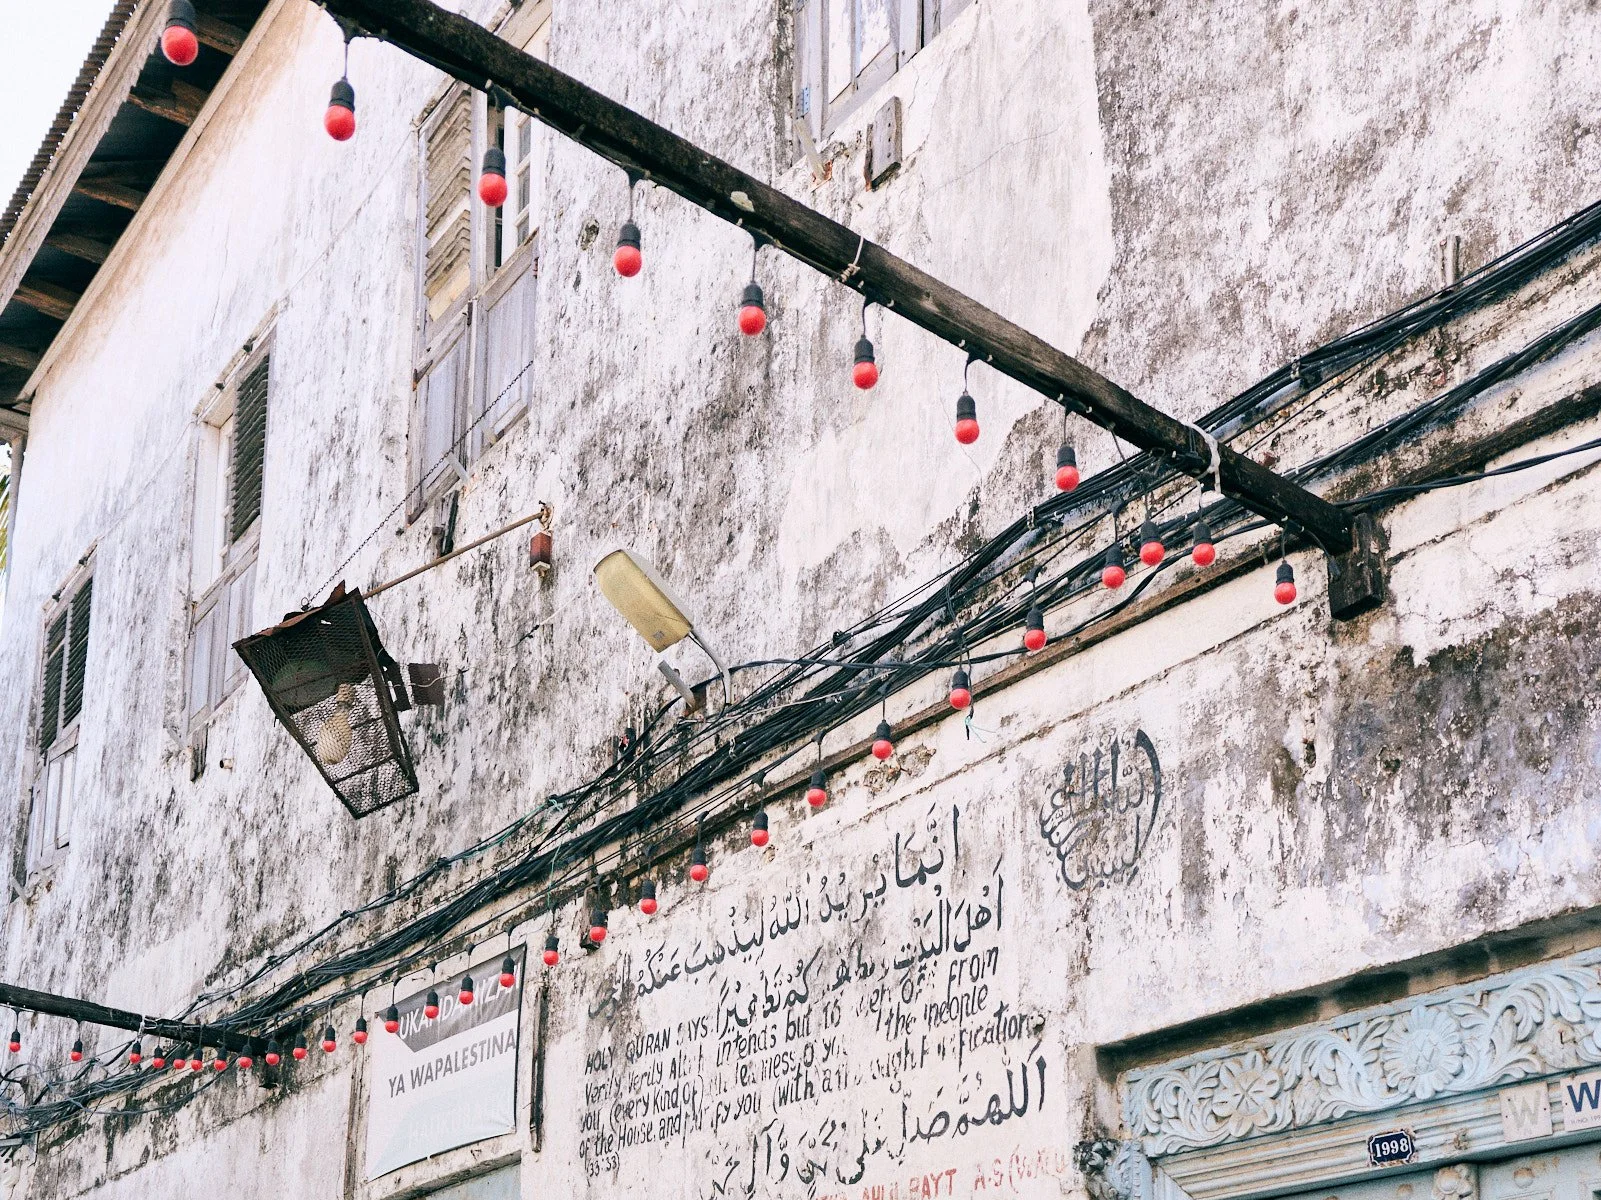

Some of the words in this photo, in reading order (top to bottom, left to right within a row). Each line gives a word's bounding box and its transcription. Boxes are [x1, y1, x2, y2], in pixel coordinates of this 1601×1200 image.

[716, 1024, 777, 1067] intends
[785, 1004, 812, 1043] but
[948, 946, 998, 1000] from
[885, 1001, 916, 1042] the
[923, 984, 988, 1032] people
[388, 1075, 405, 1098] YA
[410, 1028, 516, 1090] WAPALESTINA
[585, 1046, 615, 1075] HOLY
[625, 1027, 671, 1064] QURAN
[1567, 1079, 1601, 1113] W
[579, 1138, 590, 1170] of
[596, 1125, 613, 1157] the
[659, 1101, 682, 1140] and
[734, 1091, 761, 1120] you
[1375, 1138, 1410, 1158] 1998
